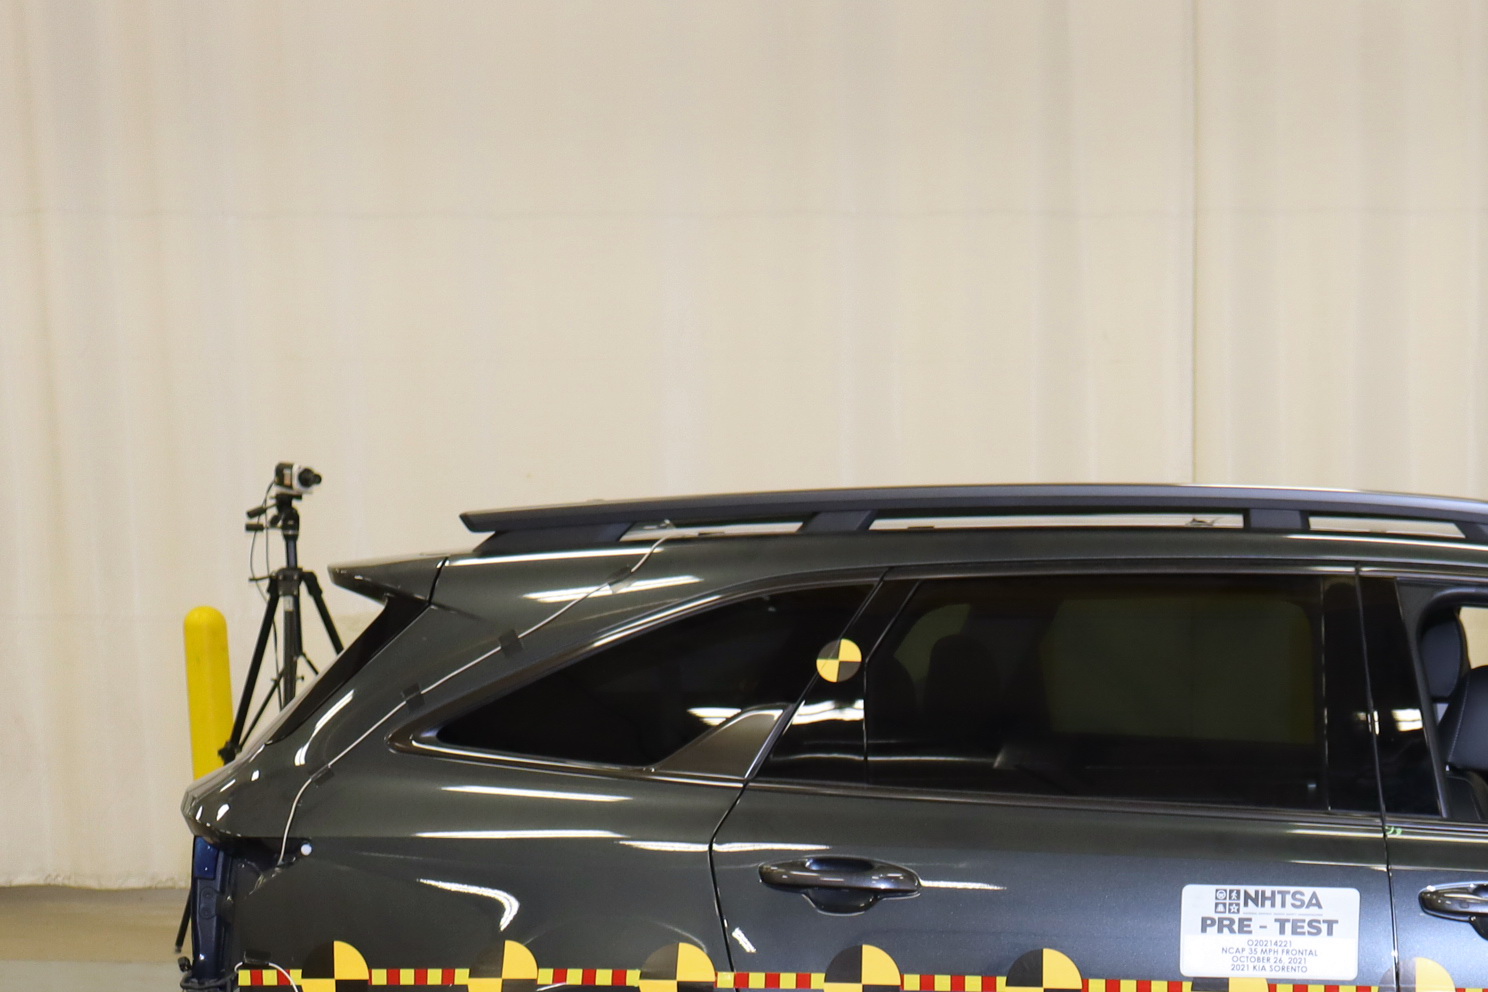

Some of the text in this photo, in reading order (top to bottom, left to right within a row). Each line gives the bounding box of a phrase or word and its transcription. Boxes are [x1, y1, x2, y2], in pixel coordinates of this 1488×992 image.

[1243, 889, 1323, 909] NHTSA
[1201, 916, 1253, 934] PRE
[1274, 918, 1339, 936] TEST
[1221, 947, 1246, 955] NCAP
[1260, 948, 1279, 956] MPH
[1281, 949, 1319, 957] FRONTAL
[1232, 956, 1271, 964] OCTOBER
[1288, 957, 1307, 965] 2021
[1231, 964, 1308, 973] 2021 KIA SORENTO
